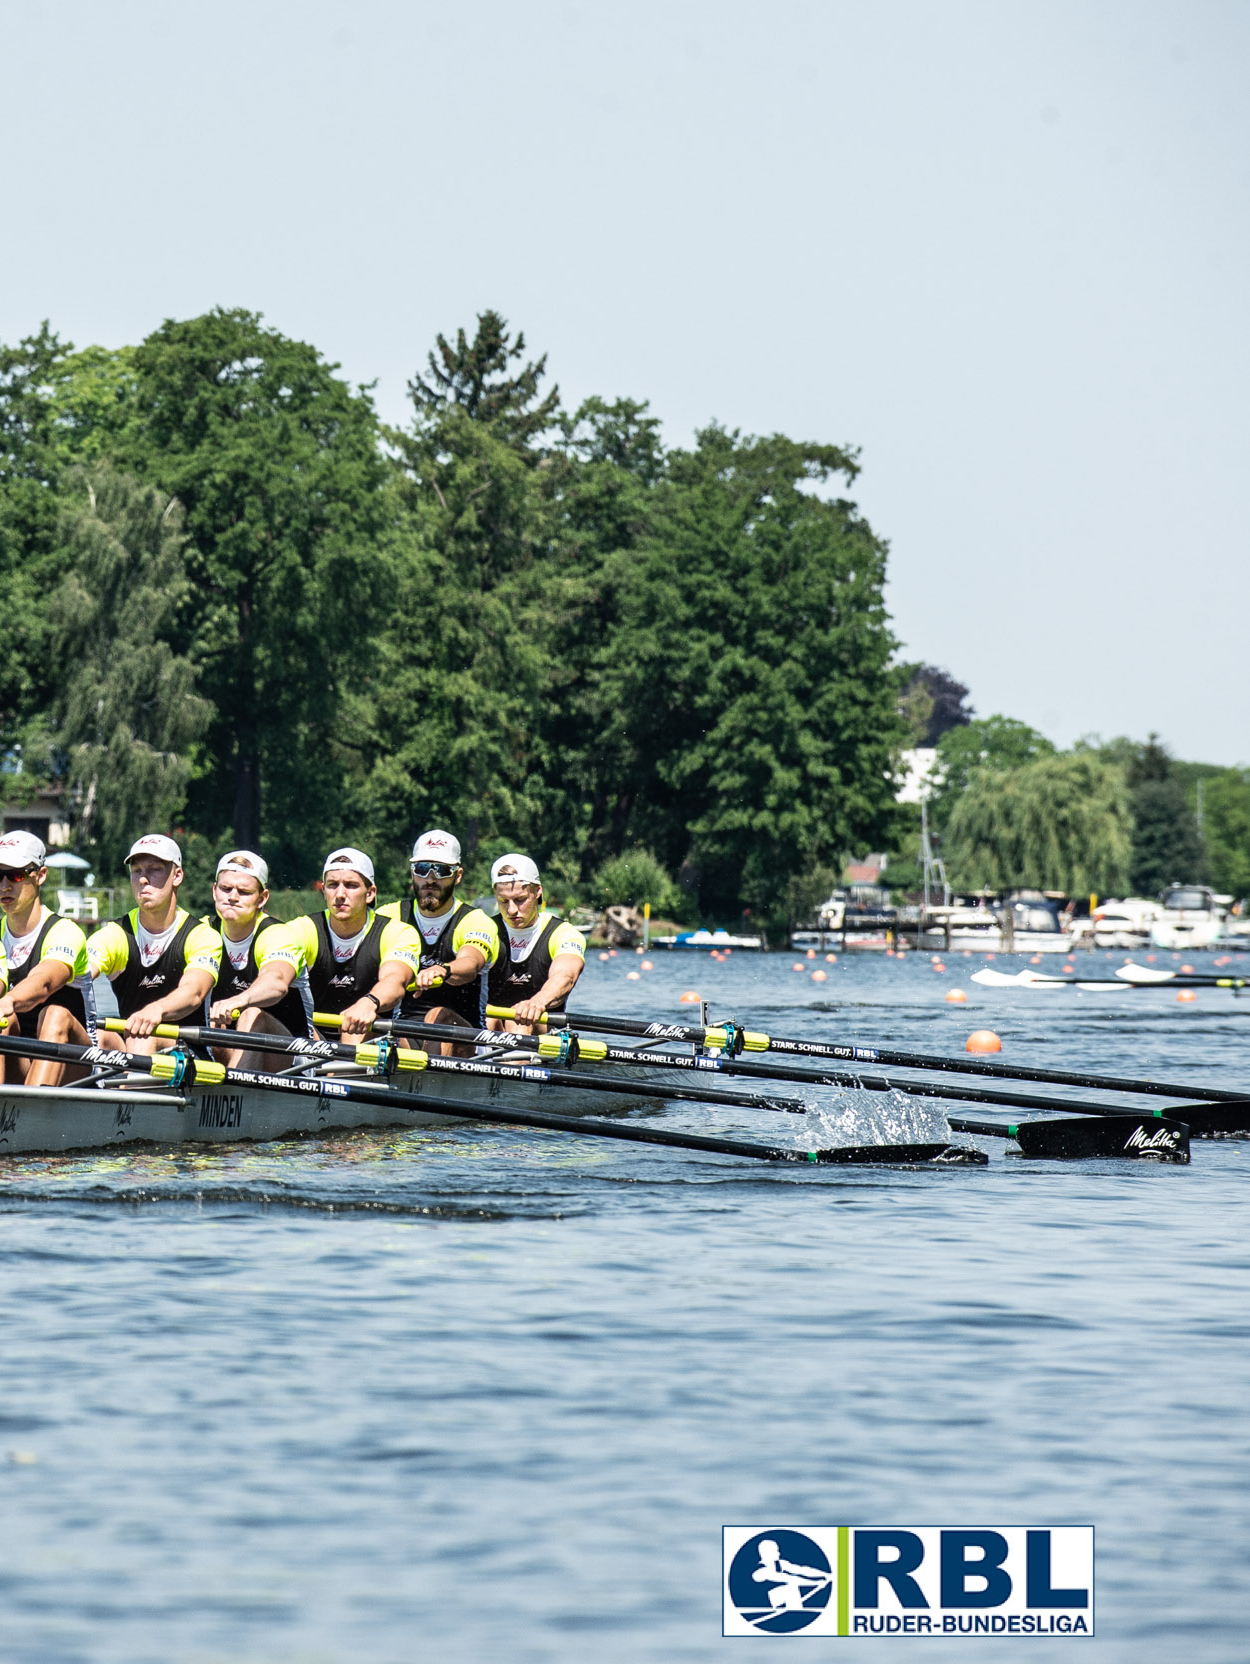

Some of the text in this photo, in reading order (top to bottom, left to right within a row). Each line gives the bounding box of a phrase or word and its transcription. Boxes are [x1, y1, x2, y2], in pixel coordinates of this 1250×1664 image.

[56, 946, 75, 958] RBL
[474, 1030, 522, 1047] Melitta
[643, 1022, 690, 1040] Melitta
[286, 1037, 338, 1057] Melitta
[771, 1040, 877, 1058] STARK. SCHNELL. GUT. RBL
[80, 1047, 133, 1068] Melitta
[609, 1049, 720, 1069] STARK. SCHNELL. GUT. RBL
[430, 1058, 548, 1079] STARK. SCHNELL. GUT. RBL
[227, 1070, 348, 1094] STARK. SCHNELL. GUT. RBL
[199, 1095, 244, 1128] MINDEN
[1124, 1125, 1180, 1149] Melitta
